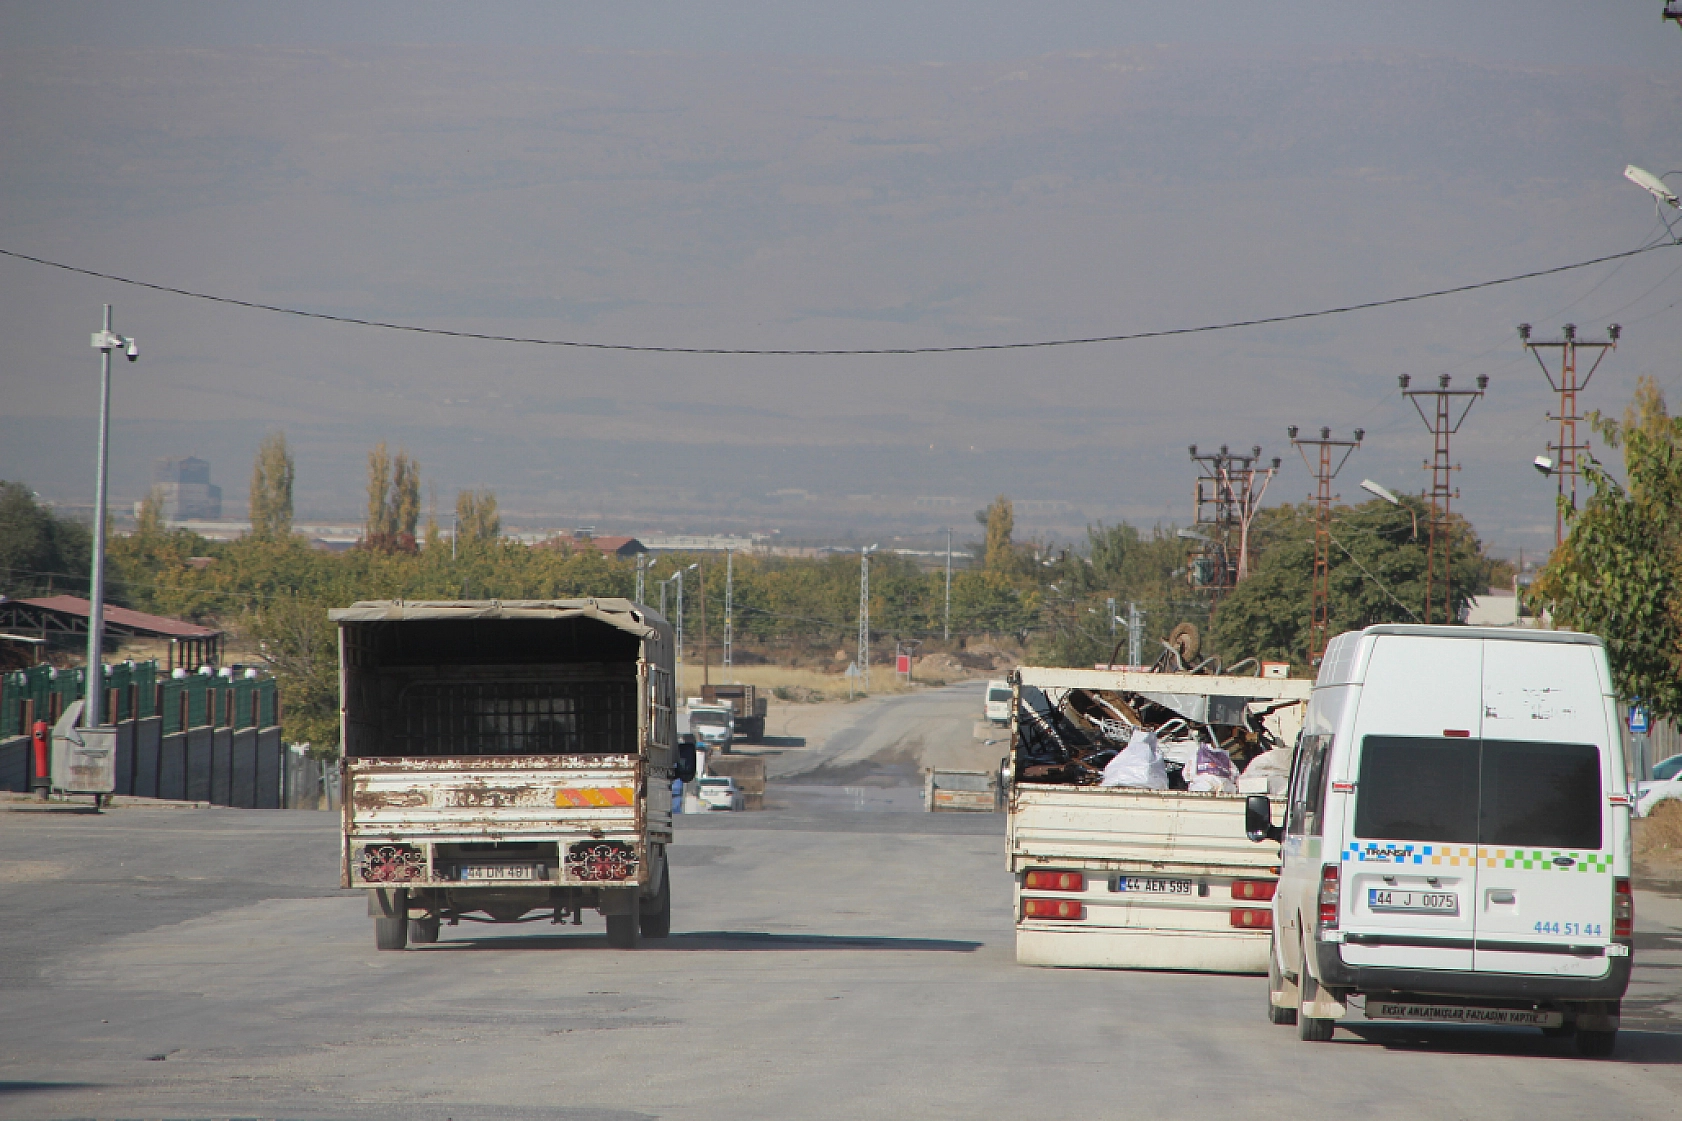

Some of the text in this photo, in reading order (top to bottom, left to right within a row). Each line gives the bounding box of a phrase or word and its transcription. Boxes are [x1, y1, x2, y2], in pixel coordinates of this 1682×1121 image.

[1365, 848, 1412, 857] TRANSIT
[468, 866, 481, 878] 44
[487, 866, 504, 878] DM
[1127, 878, 1189, 893] 44 AEN 599
[1377, 891, 1453, 908] 44 J 0075
[1533, 921, 1602, 936] 444 51 44
